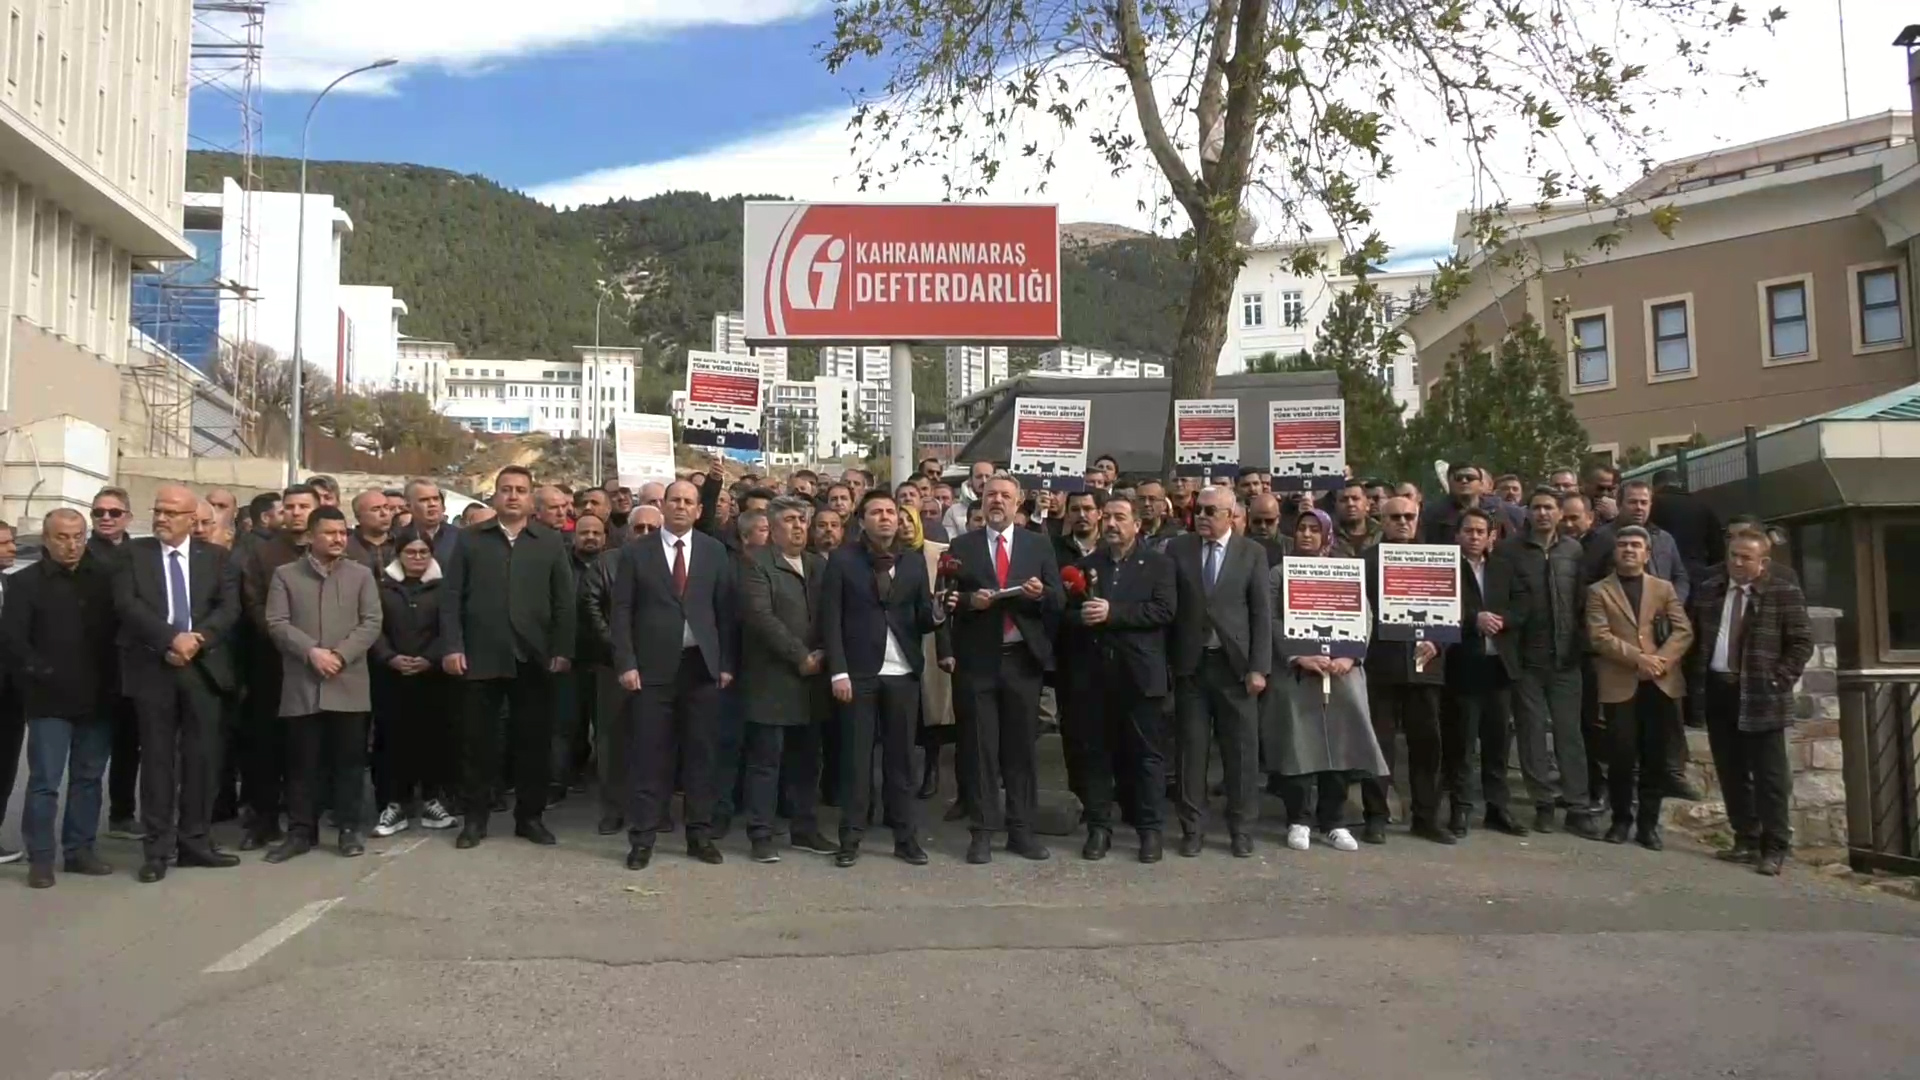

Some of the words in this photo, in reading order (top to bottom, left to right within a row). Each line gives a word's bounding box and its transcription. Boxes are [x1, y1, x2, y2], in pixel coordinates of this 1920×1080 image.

[856, 242, 1026, 266] KAHRAMANMARAŞ
[856, 268, 1052, 303] DEFTERDARLIĞI
[733, 366, 760, 374] SİSTEMİ
